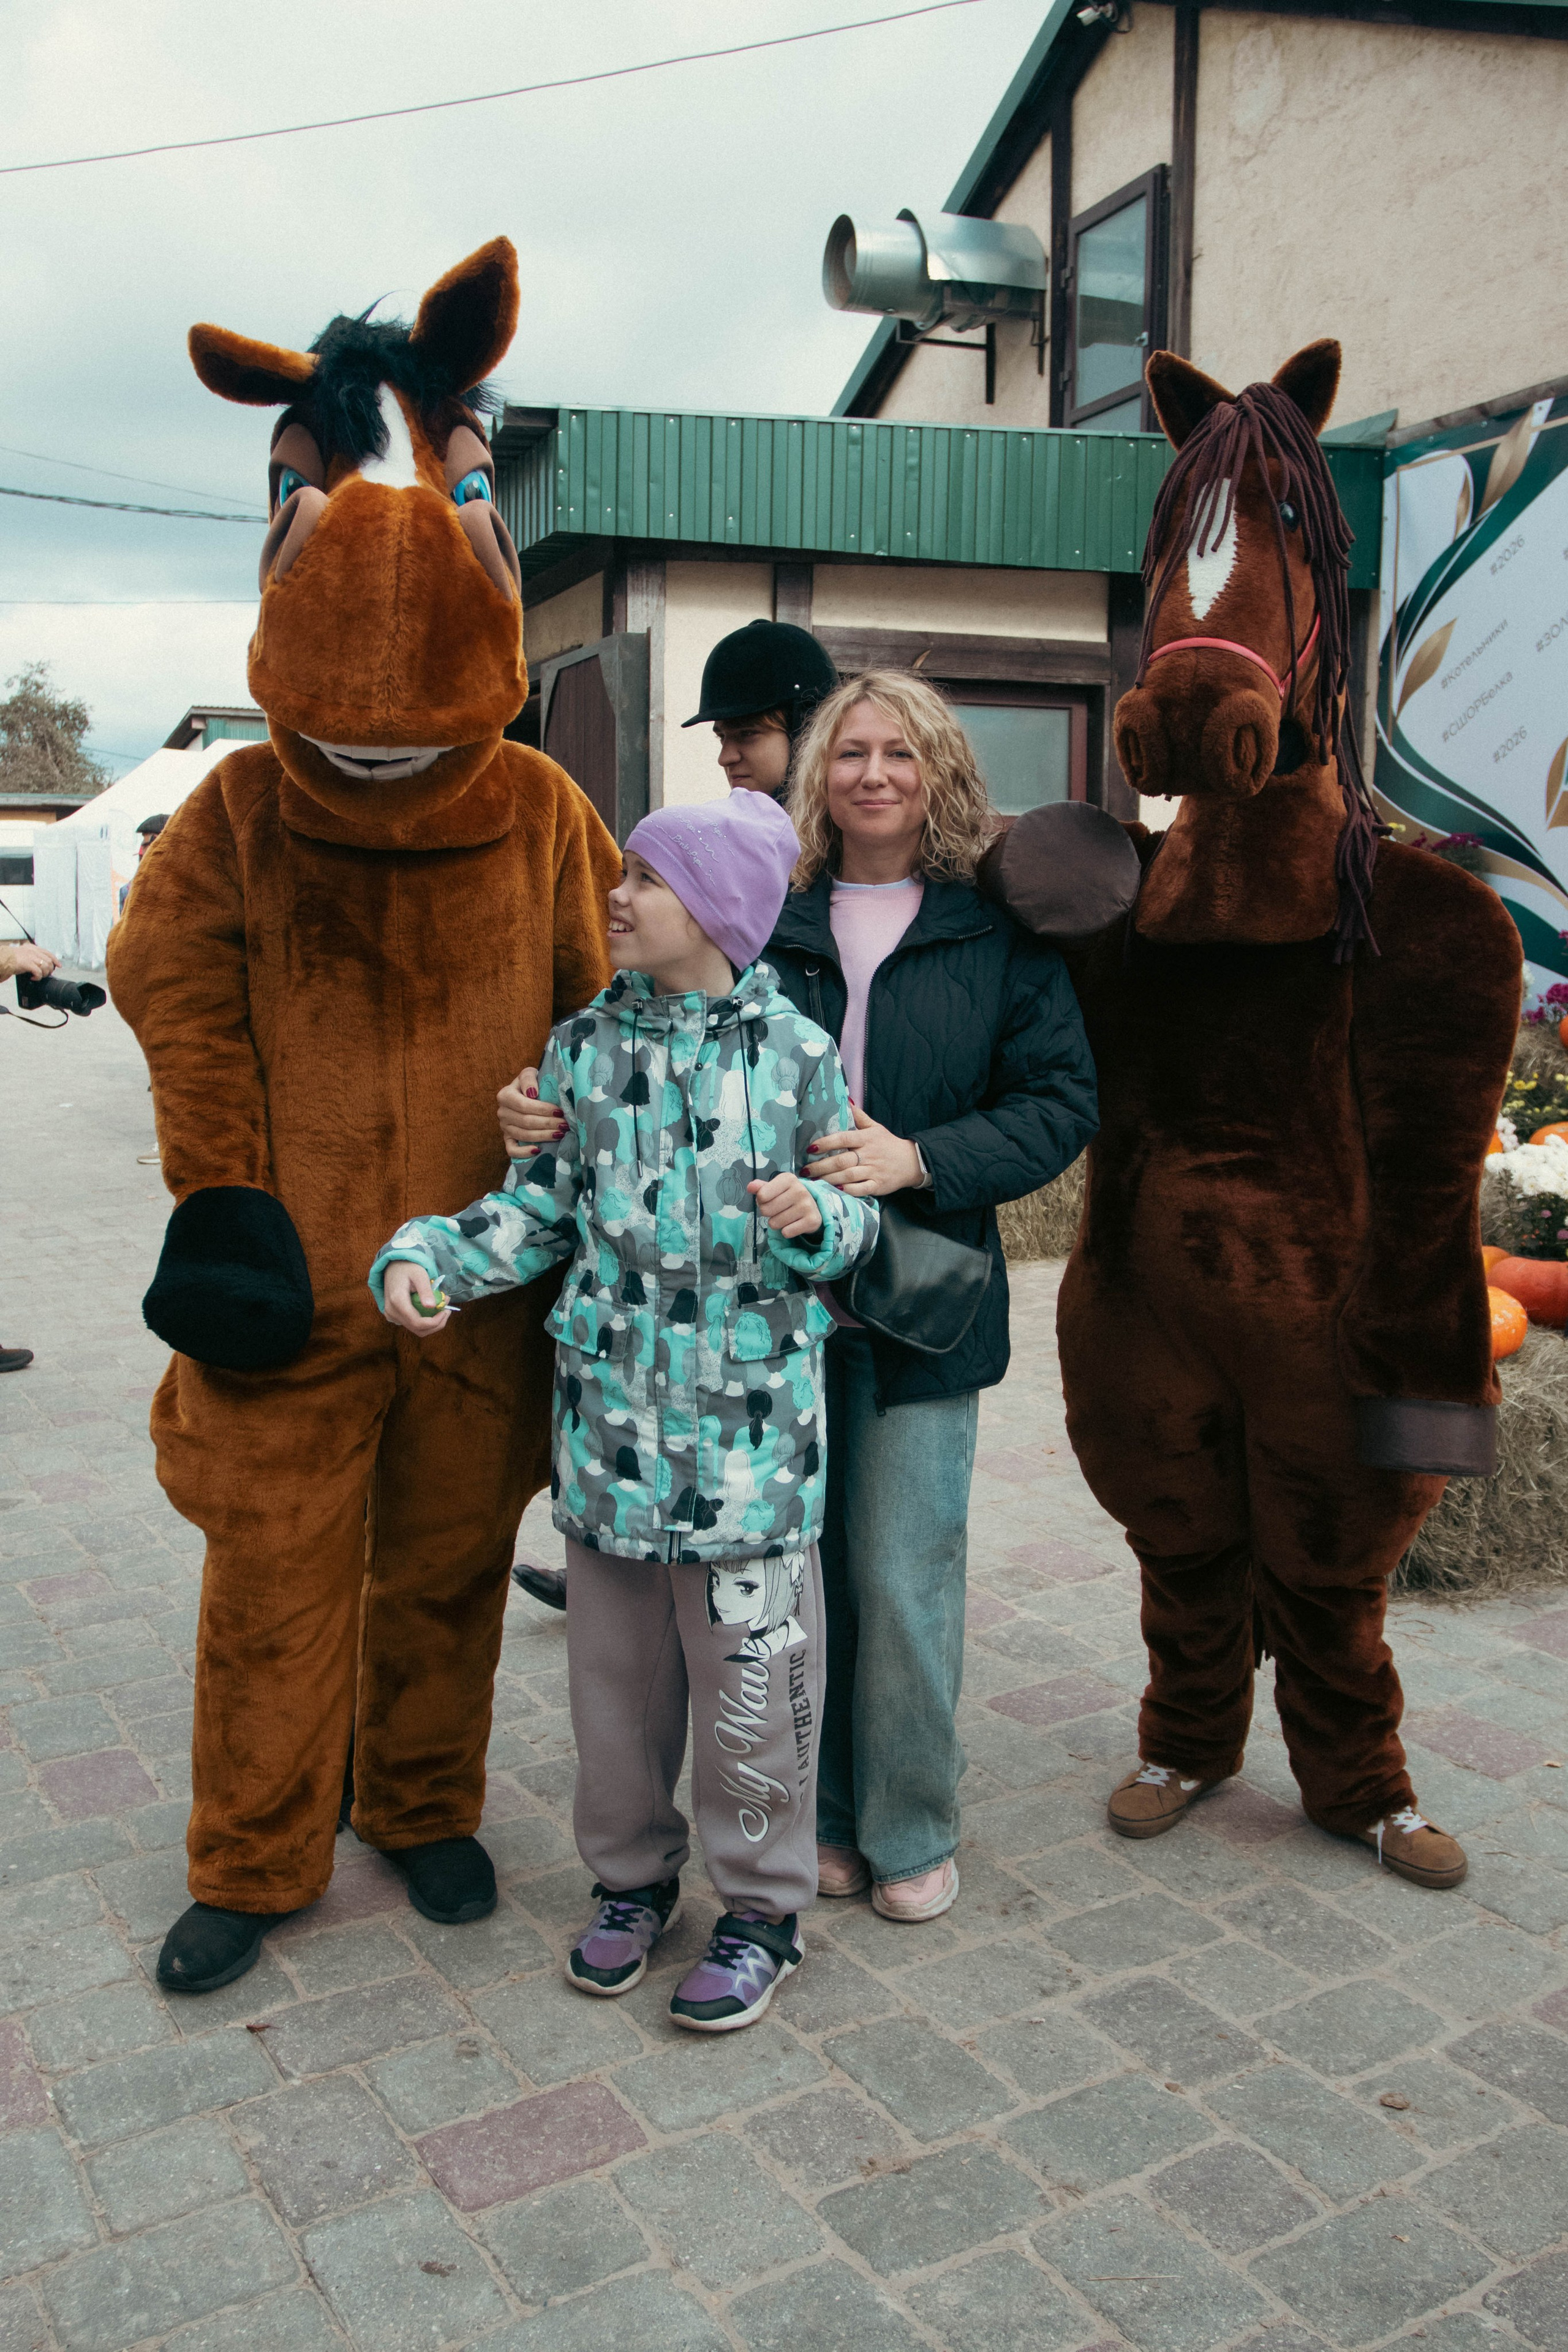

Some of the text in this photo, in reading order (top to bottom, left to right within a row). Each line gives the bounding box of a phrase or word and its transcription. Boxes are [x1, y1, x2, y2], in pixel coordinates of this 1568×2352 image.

[1490, 535, 1525, 575] #2026
[1441, 619, 1508, 689] #Котельники
[1536, 612, 1568, 652] #ЗОЛ
[1493, 726, 1527, 763] #2026
[789, 1649, 812, 1770] AUTHENTIC
[715, 1762, 790, 1842] My
